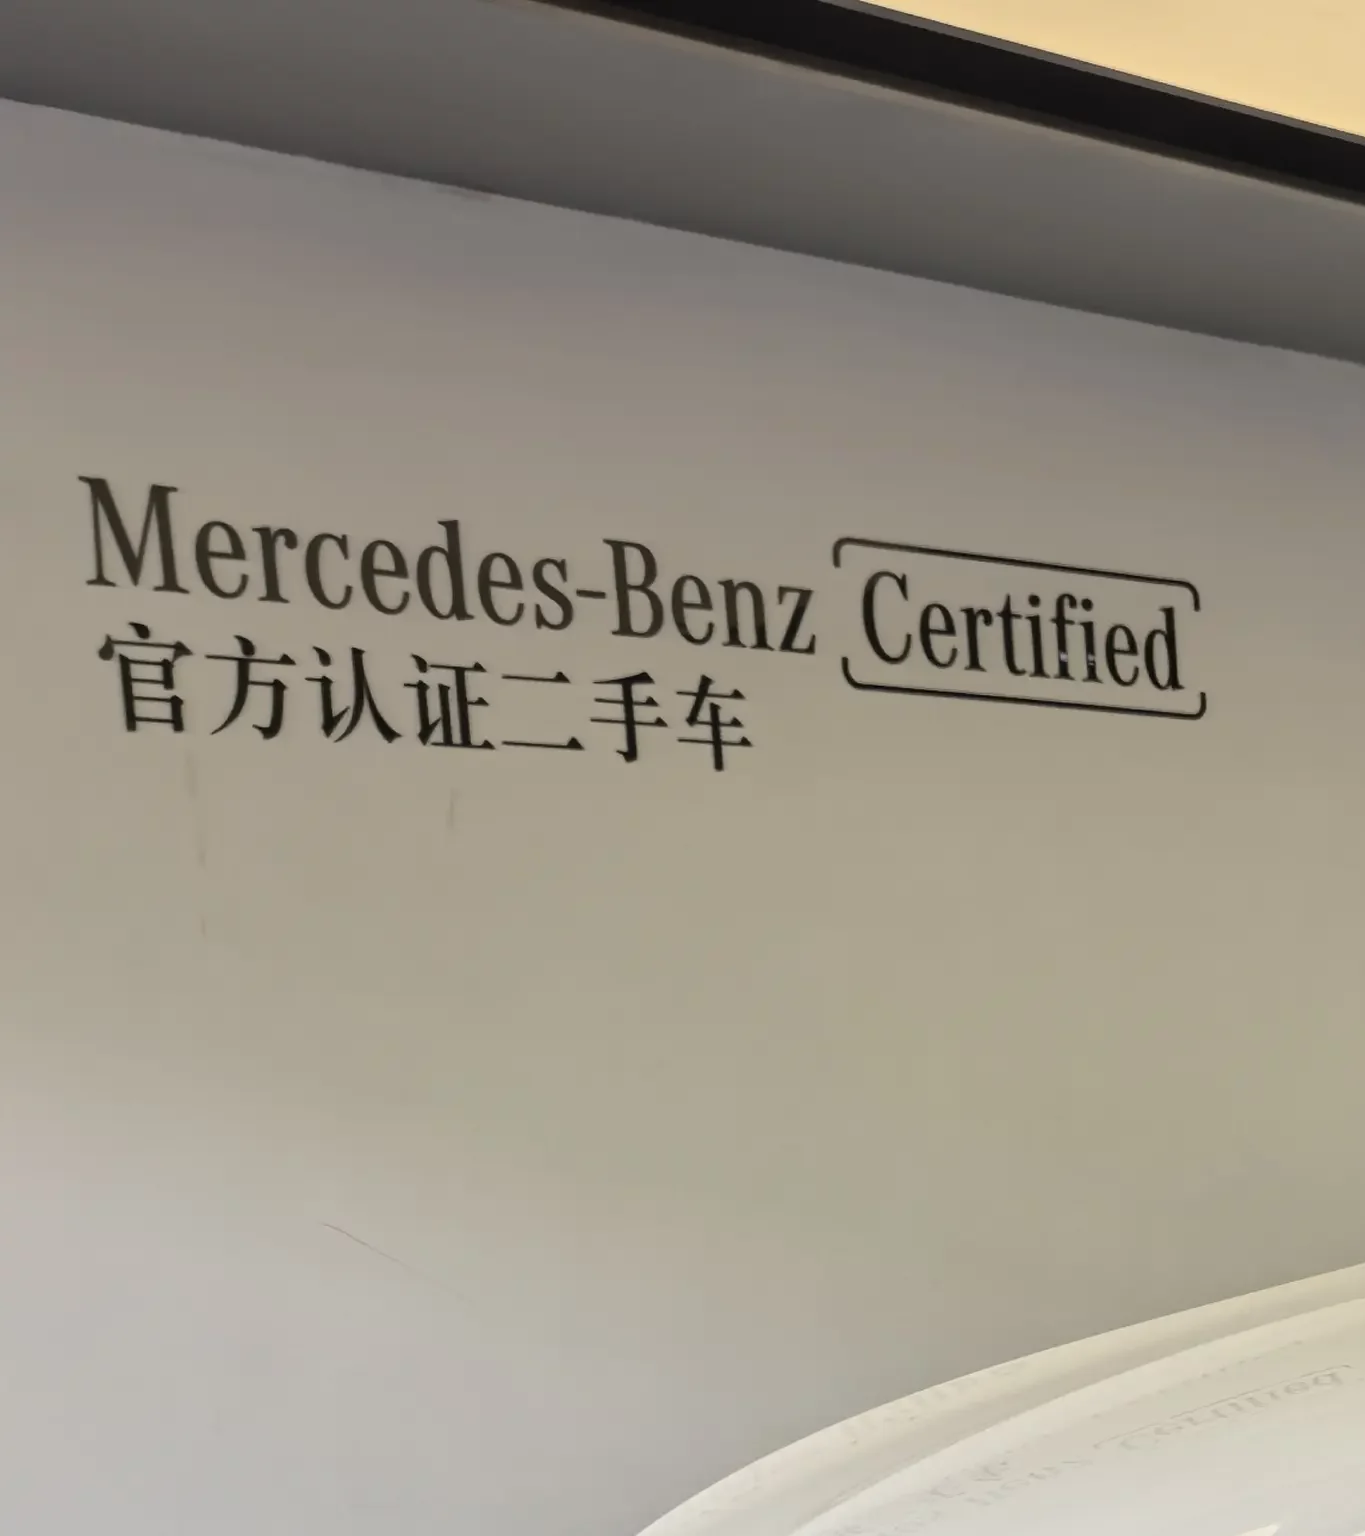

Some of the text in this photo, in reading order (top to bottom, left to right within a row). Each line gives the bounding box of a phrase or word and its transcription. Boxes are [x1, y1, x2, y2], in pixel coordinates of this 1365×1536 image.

[78, 475, 1186, 692] Mercedes-Benz Certified
[97, 621, 754, 773] 官方认证二手车
